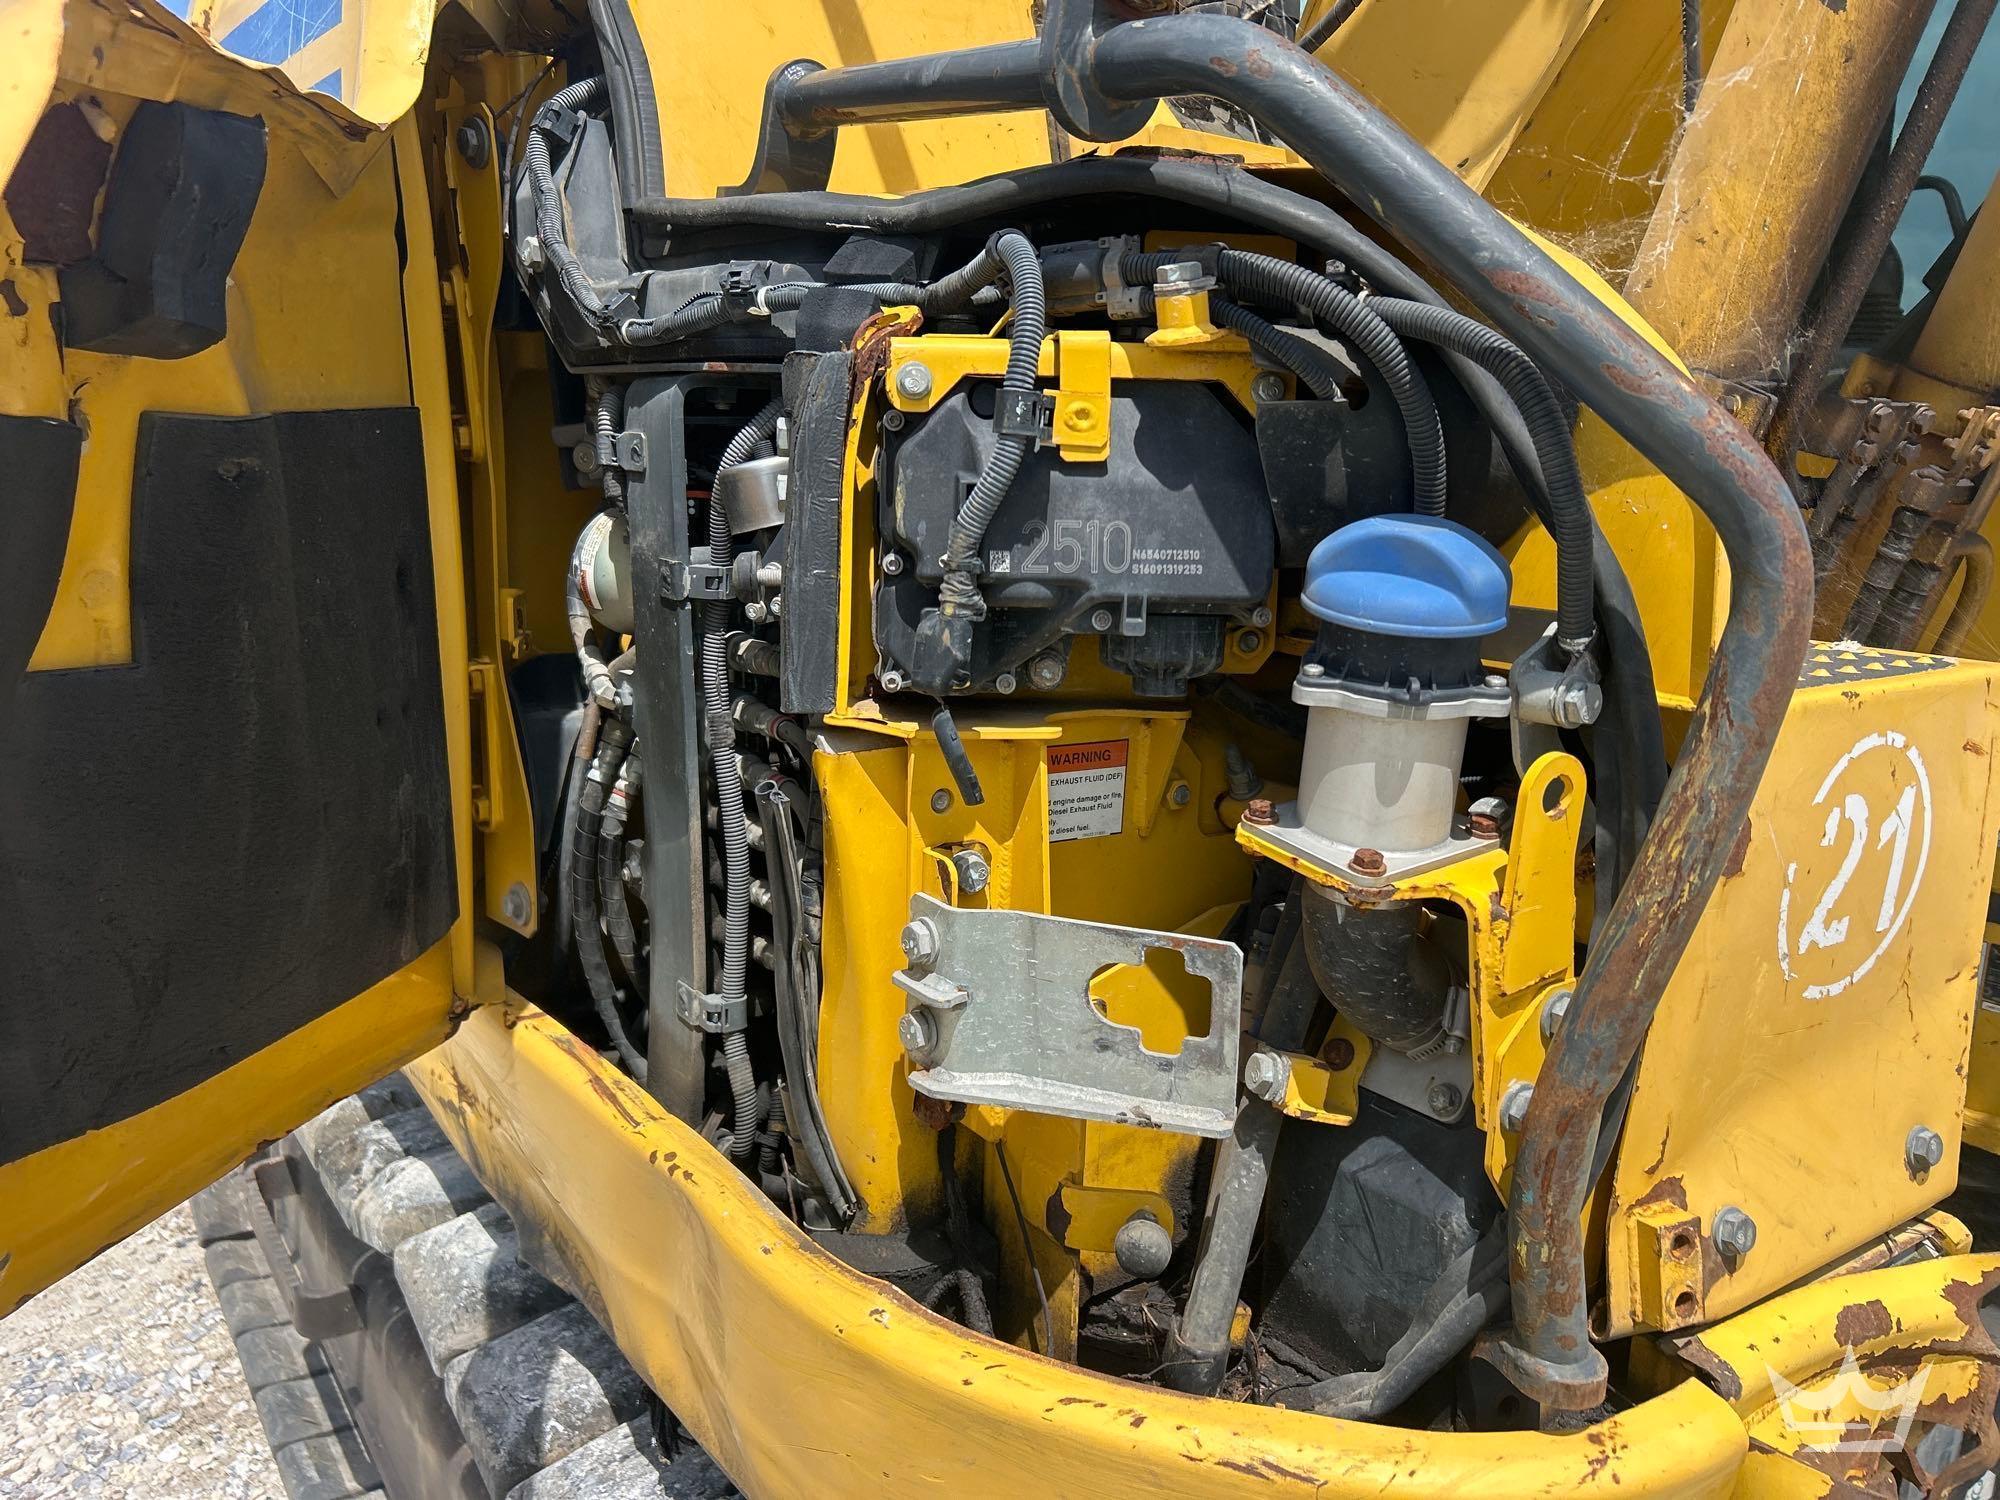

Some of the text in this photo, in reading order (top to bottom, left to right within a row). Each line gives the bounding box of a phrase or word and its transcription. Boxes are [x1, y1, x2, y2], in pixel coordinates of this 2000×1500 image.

[1021, 519, 1131, 574] 2510
[1050, 749, 1111, 766] WARNING
[1050, 772, 1123, 787] EXHAUST FLUID (DEF)
[1052, 797, 1076, 807] engine
[1076, 794, 1102, 804] damage
[1048, 801, 1113, 816] Diesel Exhaust Fluid
[1055, 825, 1076, 835] diesel
[1798, 783, 1917, 955] 21
